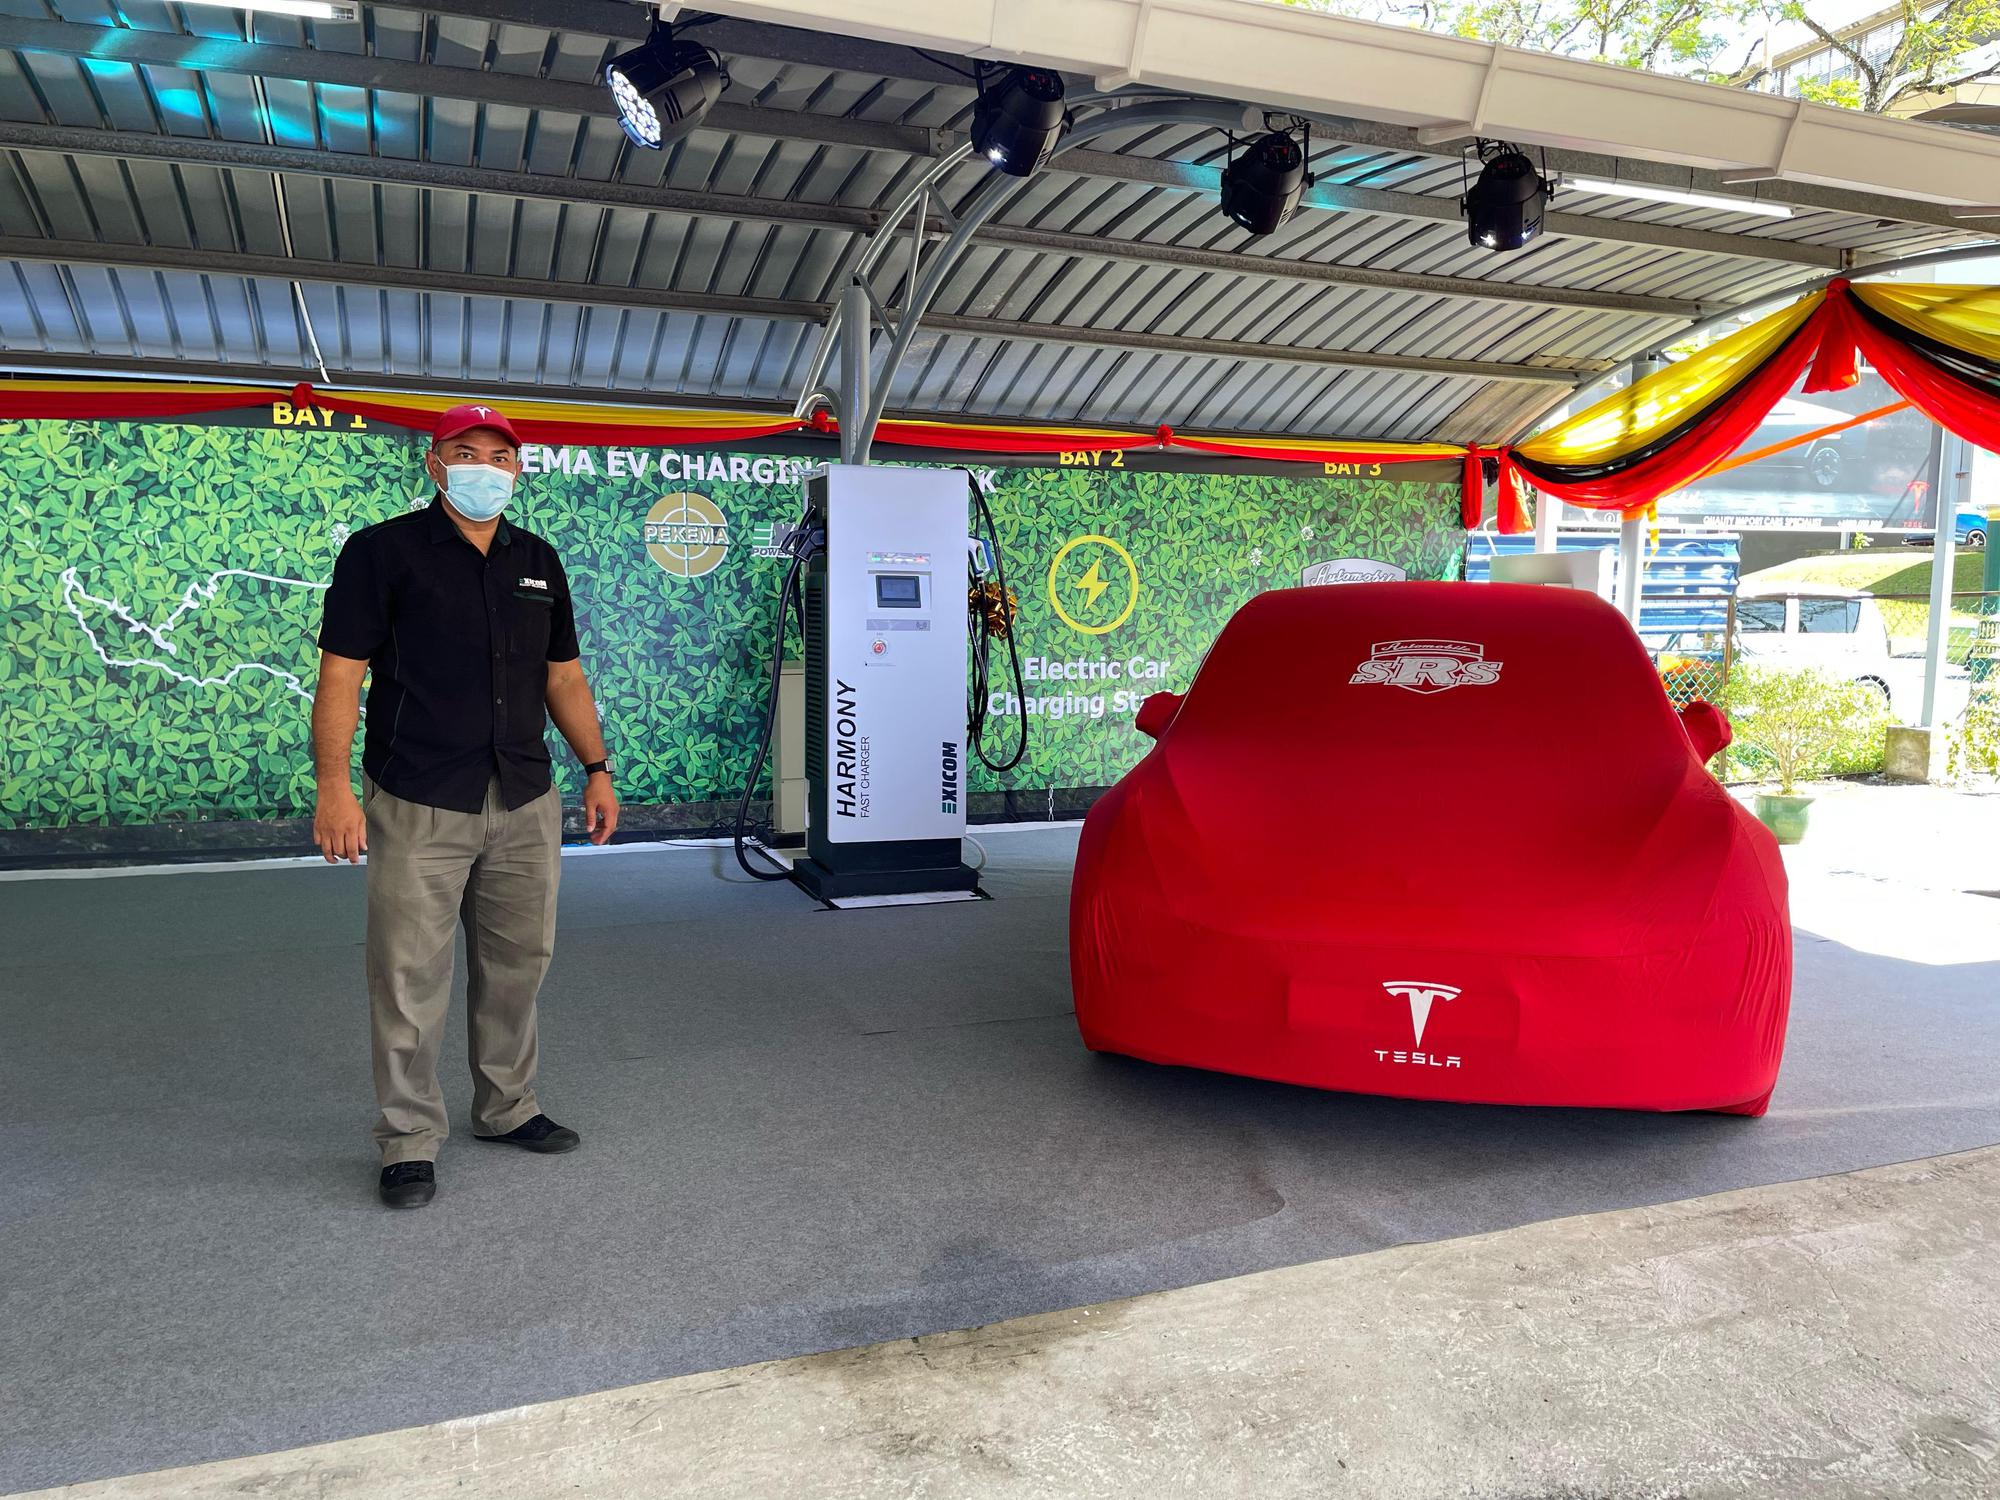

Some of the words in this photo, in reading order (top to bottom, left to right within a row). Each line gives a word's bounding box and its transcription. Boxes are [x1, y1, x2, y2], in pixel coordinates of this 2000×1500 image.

[273, 401, 334, 427] BAY
[521, 445, 597, 476] EMA
[607, 450, 650, 478] EV
[660, 453, 832, 485] CHARGIN
[1059, 450, 1103, 467] BAY
[1111, 448, 1125, 468] 2
[1369, 462, 1382, 477] 3
[644, 524, 730, 545] PEKEMA
[751, 546, 794, 559] POWE
[1381, 641, 1471, 652] Automobile
[1024, 656, 1121, 680] Electric
[1127, 656, 1170, 679] Car
[1348, 656, 1503, 686] SRS
[986, 690, 1104, 720] Charging
[837, 678, 857, 818] HARMONY
[860, 736, 870, 789] CHARGER
[941, 741, 957, 815] EXICOM
[860, 793, 870, 818] FAST
[1374, 1049, 1461, 1068] TESLA
